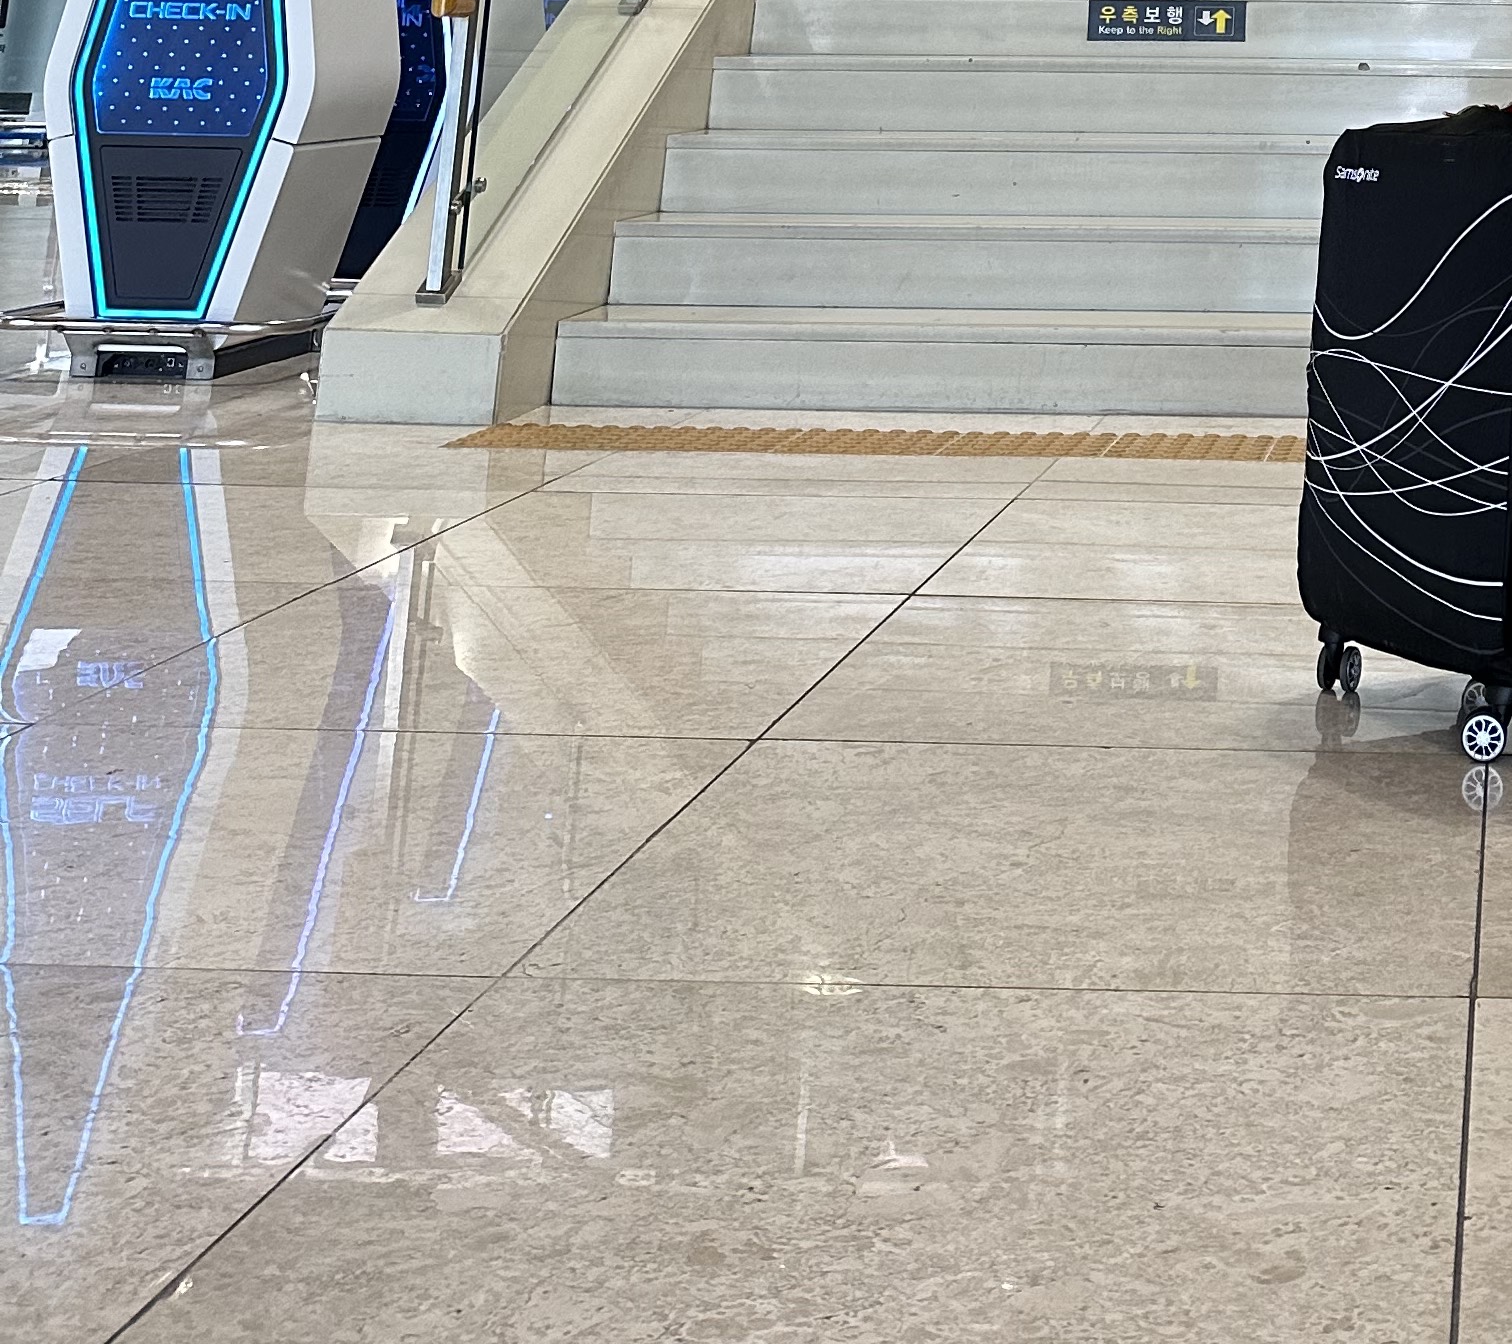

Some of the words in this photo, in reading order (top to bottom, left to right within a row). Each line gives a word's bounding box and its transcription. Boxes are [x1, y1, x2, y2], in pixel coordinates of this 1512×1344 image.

[129, 1, 252, 21] CHECK-IN
[1098, 25, 1124, 36] Keep
[1126, 26, 1136, 35] to
[1138, 26, 1155, 35] the
[1157, 26, 1183, 36] Right
[148, 77, 214, 100] KAC
[1334, 165, 1380, 183] Samsonite
